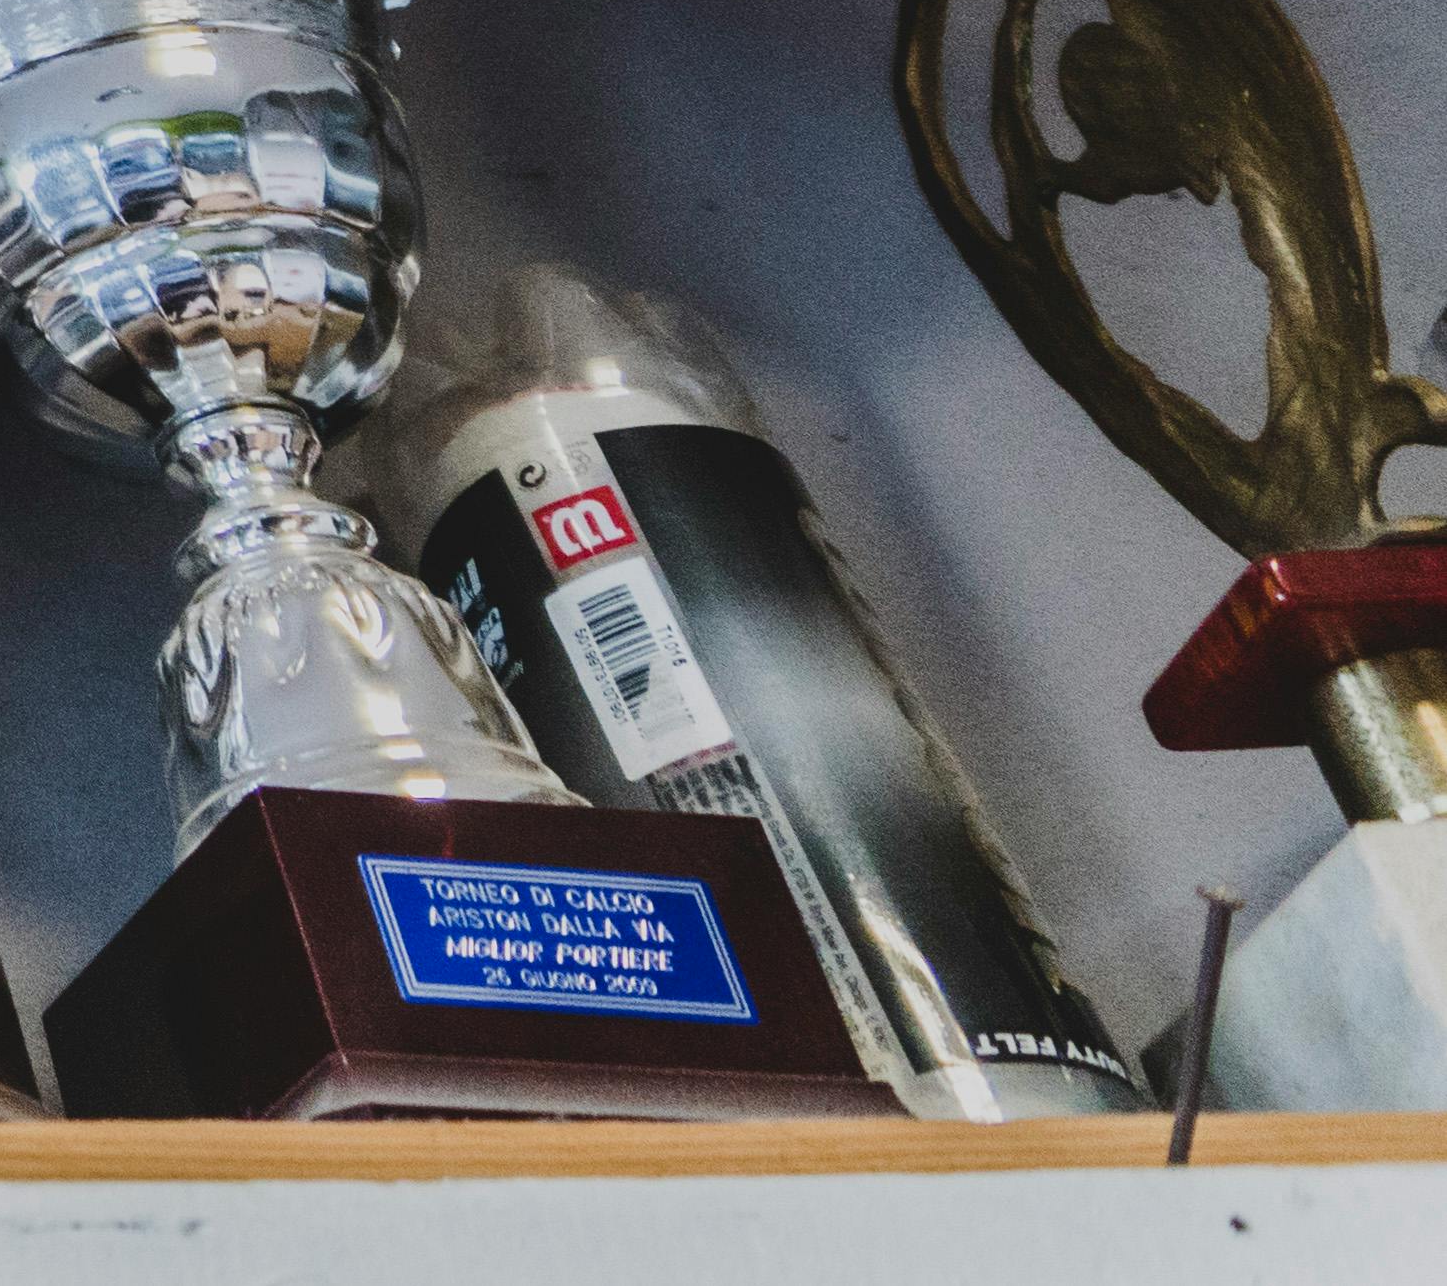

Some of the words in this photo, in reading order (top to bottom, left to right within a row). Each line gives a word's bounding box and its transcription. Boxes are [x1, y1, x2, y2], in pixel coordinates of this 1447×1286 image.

[419, 877, 521, 905] TORNEO
[531, 886, 556, 908] DI
[565, 888, 655, 916] CALCIO
[428, 905, 532, 932] ARISTON
[541, 912, 621, 940] DALLA
[631, 919, 675, 944] VIA
[445, 935, 544, 963] MIGLIOR
[556, 941, 674, 973] PORTIERE
[520, 968, 597, 993] GIUGNO
[975, 1031, 1058, 1057] FELT
